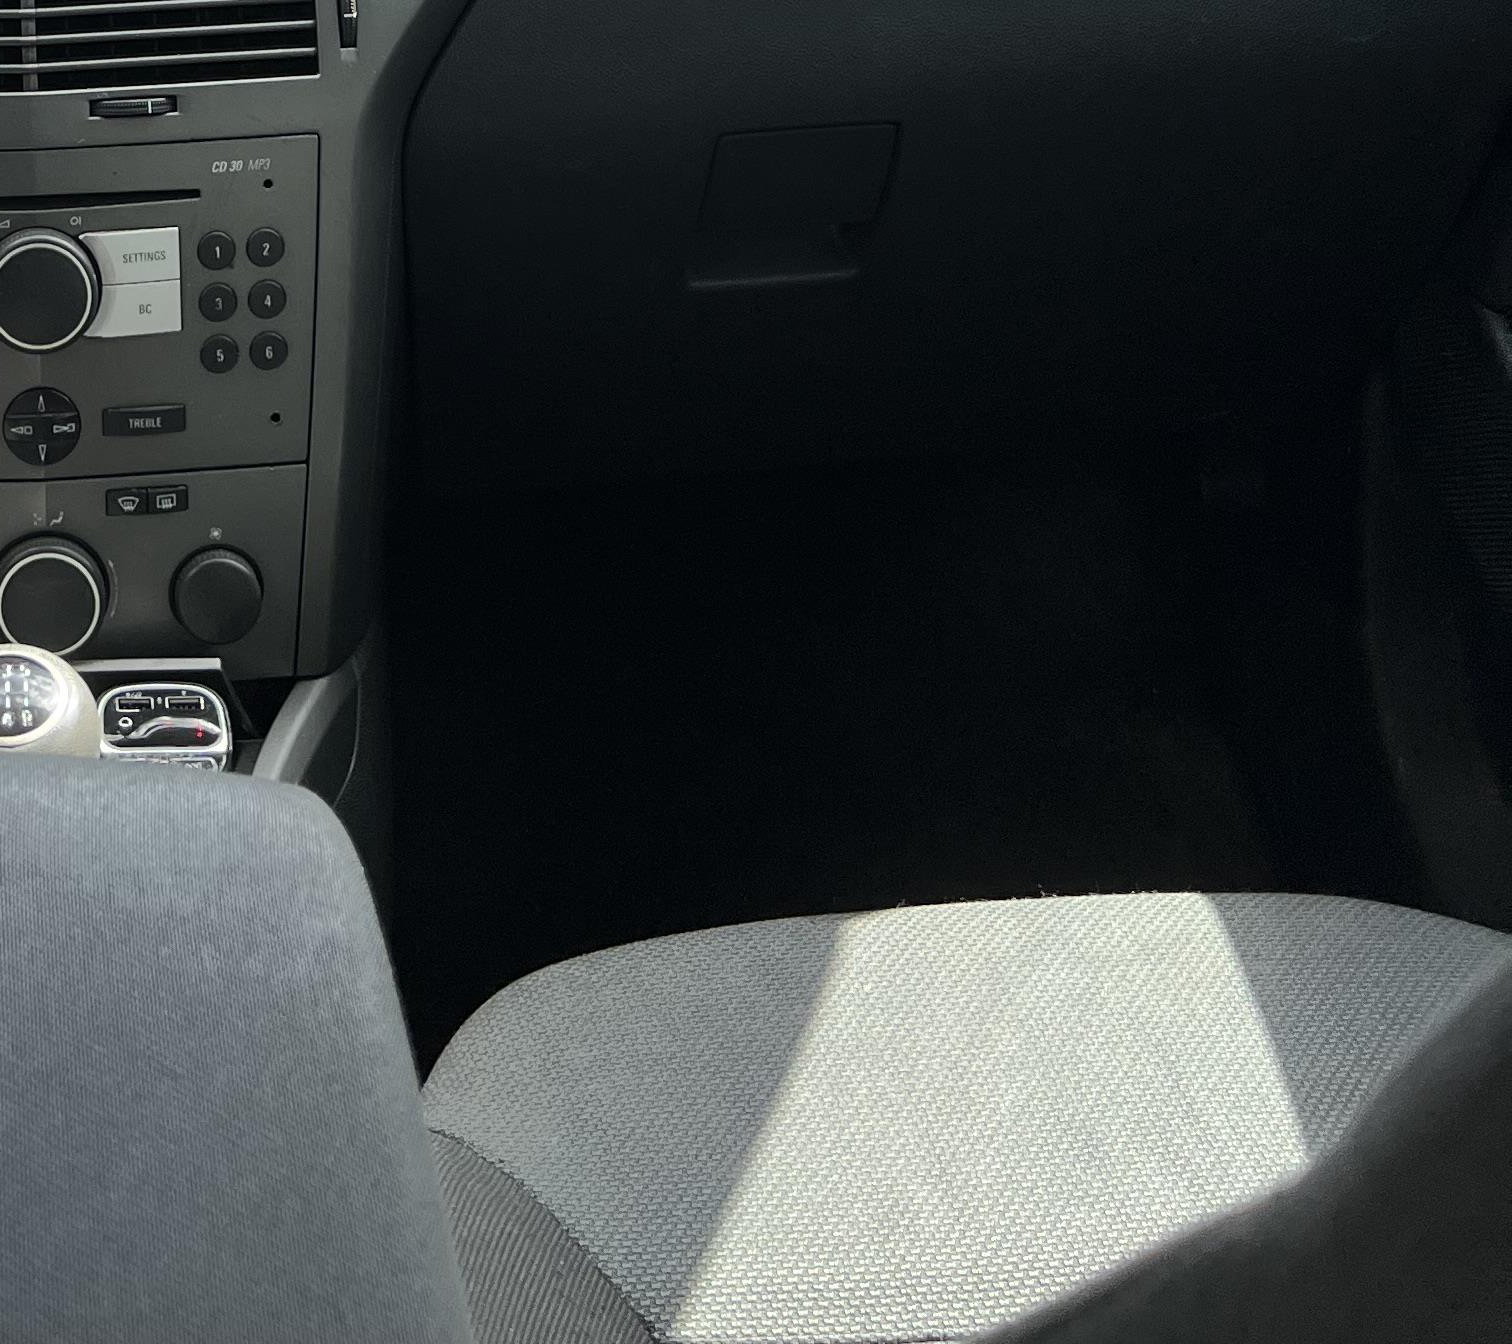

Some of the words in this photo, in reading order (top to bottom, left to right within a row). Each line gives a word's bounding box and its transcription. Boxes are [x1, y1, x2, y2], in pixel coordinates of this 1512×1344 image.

[211, 160, 228, 173] CD
[229, 159, 244, 172] 30
[247, 157, 271, 171] MP3
[214, 245, 221, 259] 1
[261, 242, 270, 256] 2
[122, 250, 167, 264] SETTINGS
[214, 297, 223, 311] 3
[264, 294, 272, 308] 4
[138, 304, 152, 315] BC
[215, 349, 225, 363] 5
[264, 346, 273, 360] 6
[128, 416, 163, 429] TREBLE
